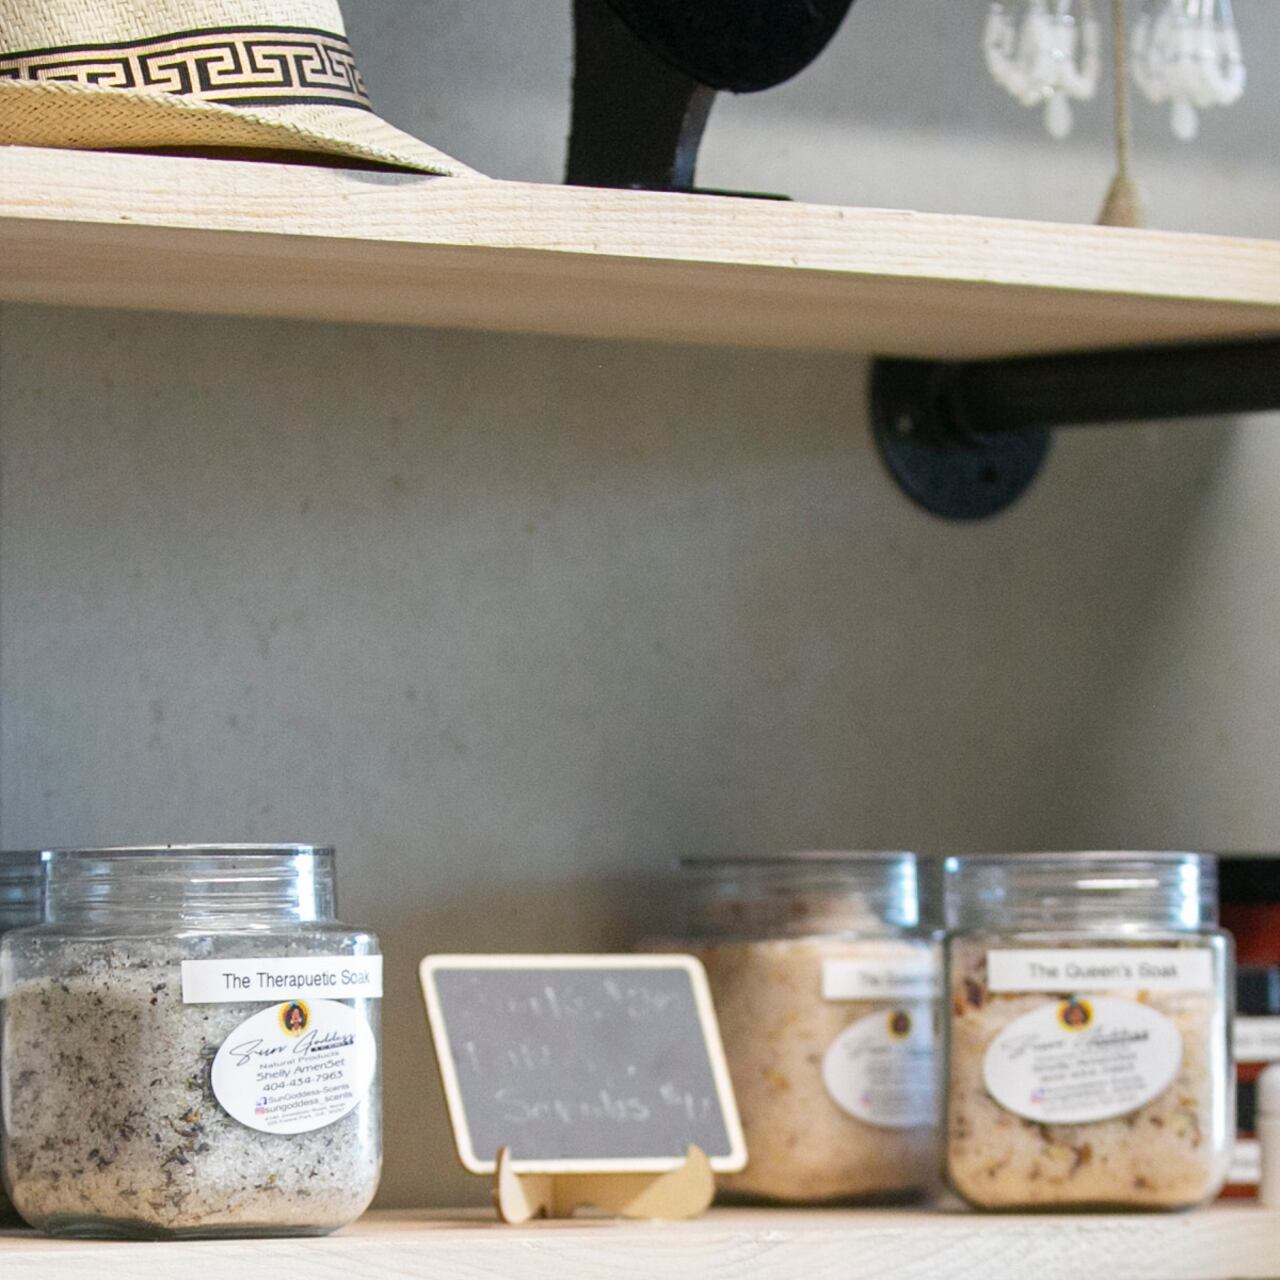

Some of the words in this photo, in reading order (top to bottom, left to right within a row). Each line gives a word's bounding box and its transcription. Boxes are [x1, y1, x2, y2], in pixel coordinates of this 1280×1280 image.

[222, 972, 251, 989] The
[256, 971, 337, 990] Therapuetic
[341, 968, 370, 985] Soak
[1028, 962, 1059, 979] The
[255, 1068, 291, 1083] Shelly
